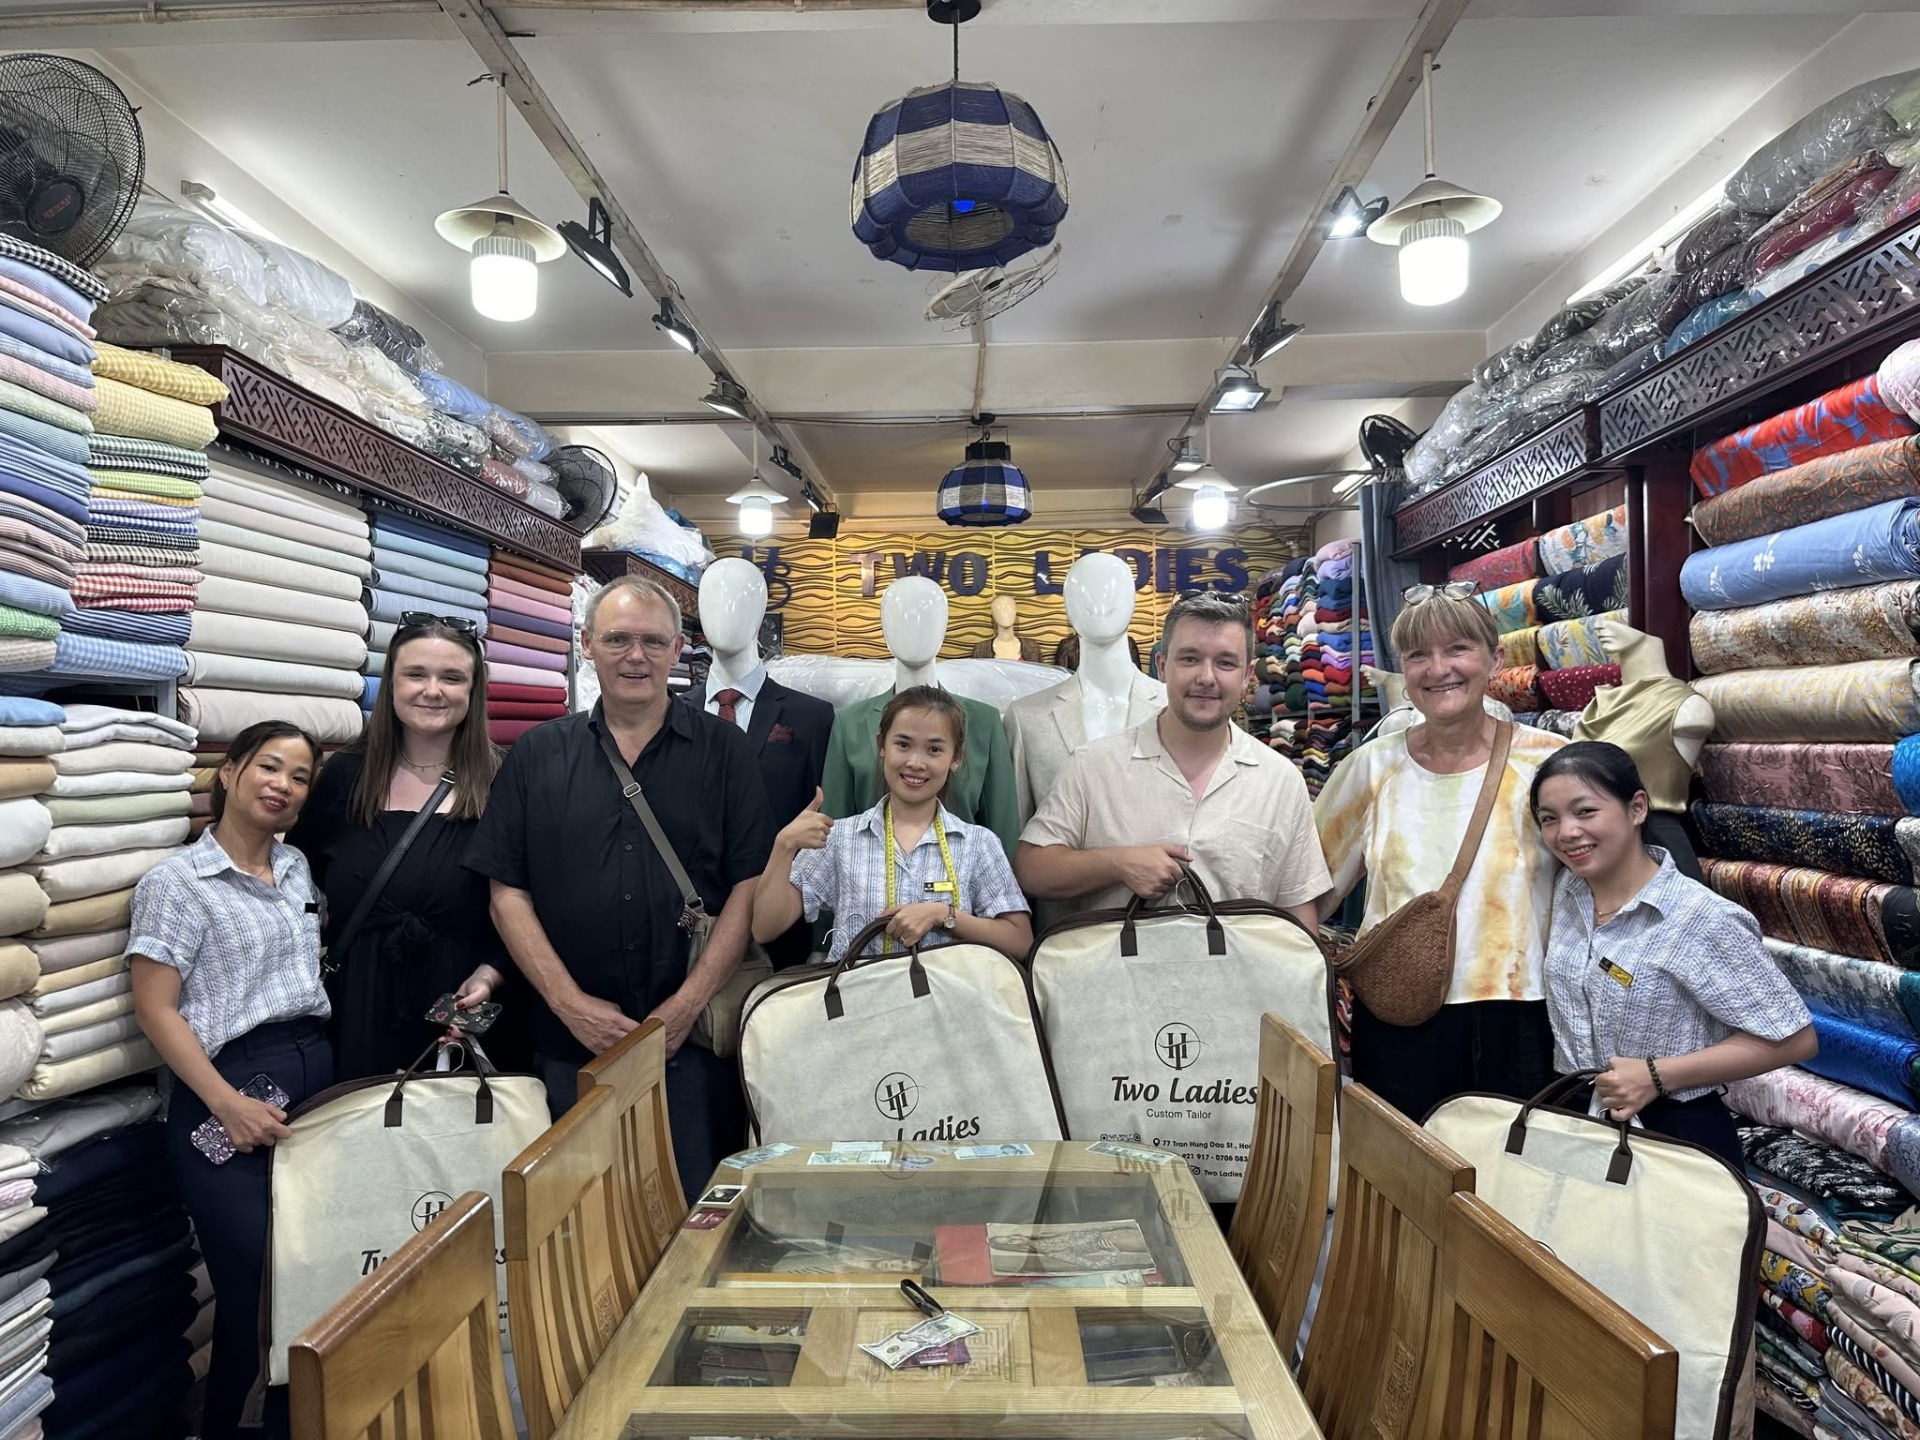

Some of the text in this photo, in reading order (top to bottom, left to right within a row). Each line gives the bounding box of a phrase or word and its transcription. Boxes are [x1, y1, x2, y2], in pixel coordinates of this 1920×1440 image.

[850, 548, 1249, 597] TWO LDIES
[1111, 1076, 1258, 1104] Two Ladies
[1146, 1108, 1212, 1119] Custom Tailor
[1189, 1141, 1208, 1149] Hung
[1219, 1170, 1243, 1178] Ladies
